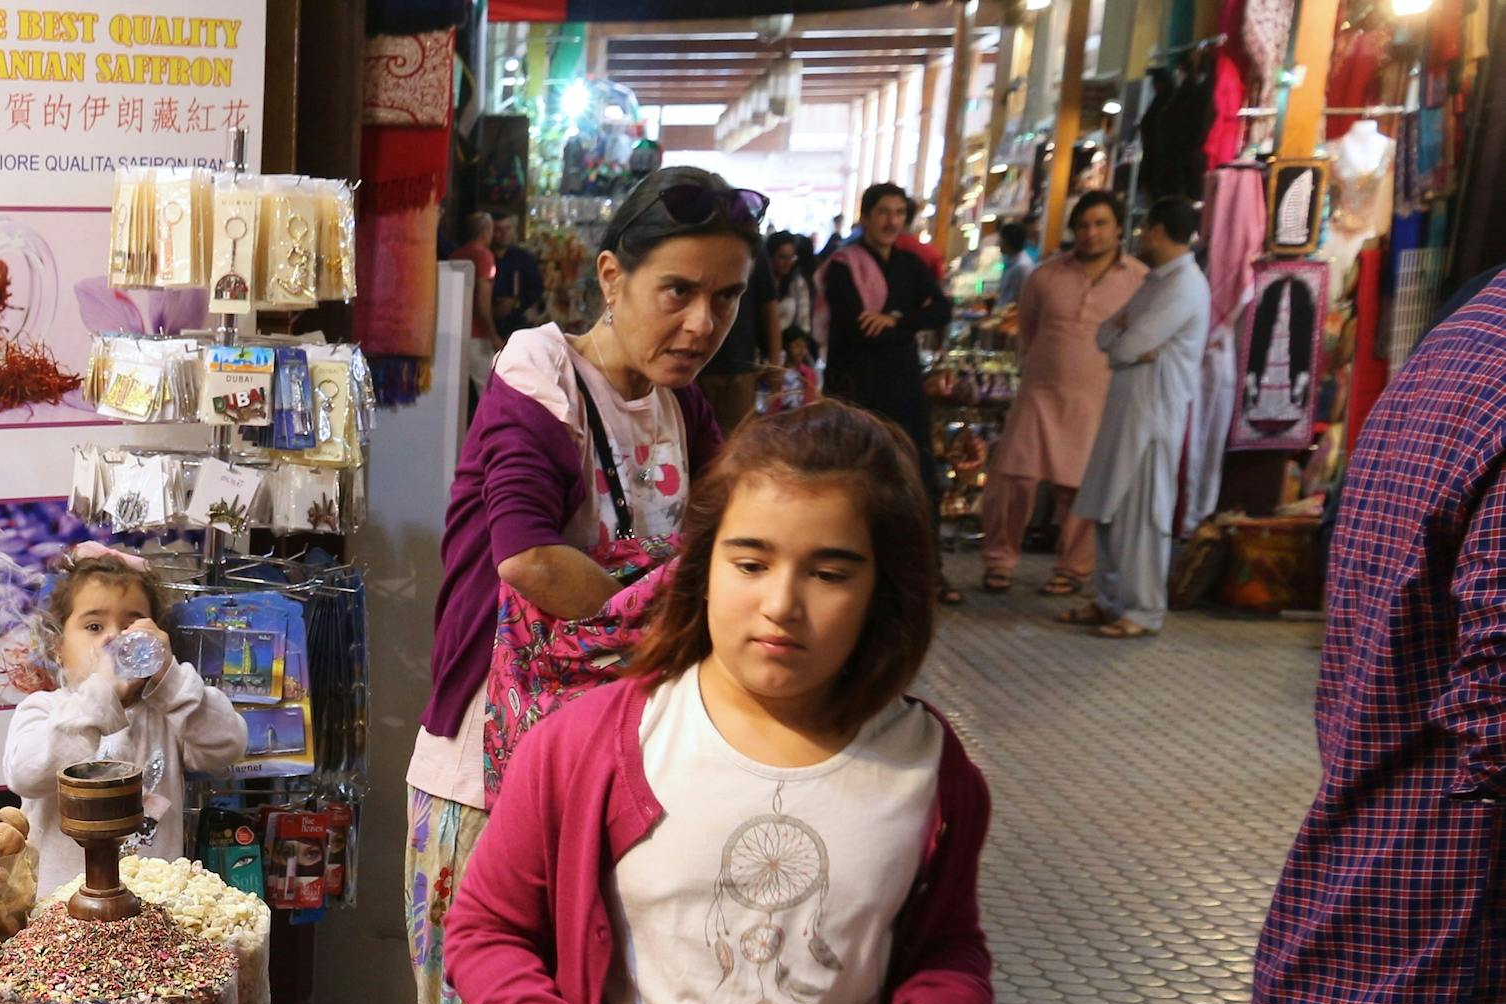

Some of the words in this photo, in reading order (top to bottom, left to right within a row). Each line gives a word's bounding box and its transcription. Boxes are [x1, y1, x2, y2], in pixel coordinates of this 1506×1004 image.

[17, 10, 99, 42] BEST
[109, 14, 242, 49] QUALITY
[95, 53, 233, 87] SAFFRON
[45, 155, 116, 172] QUALITA
[226, 375, 253, 383] DUBAI
[212, 386, 266, 414] DUBAI
